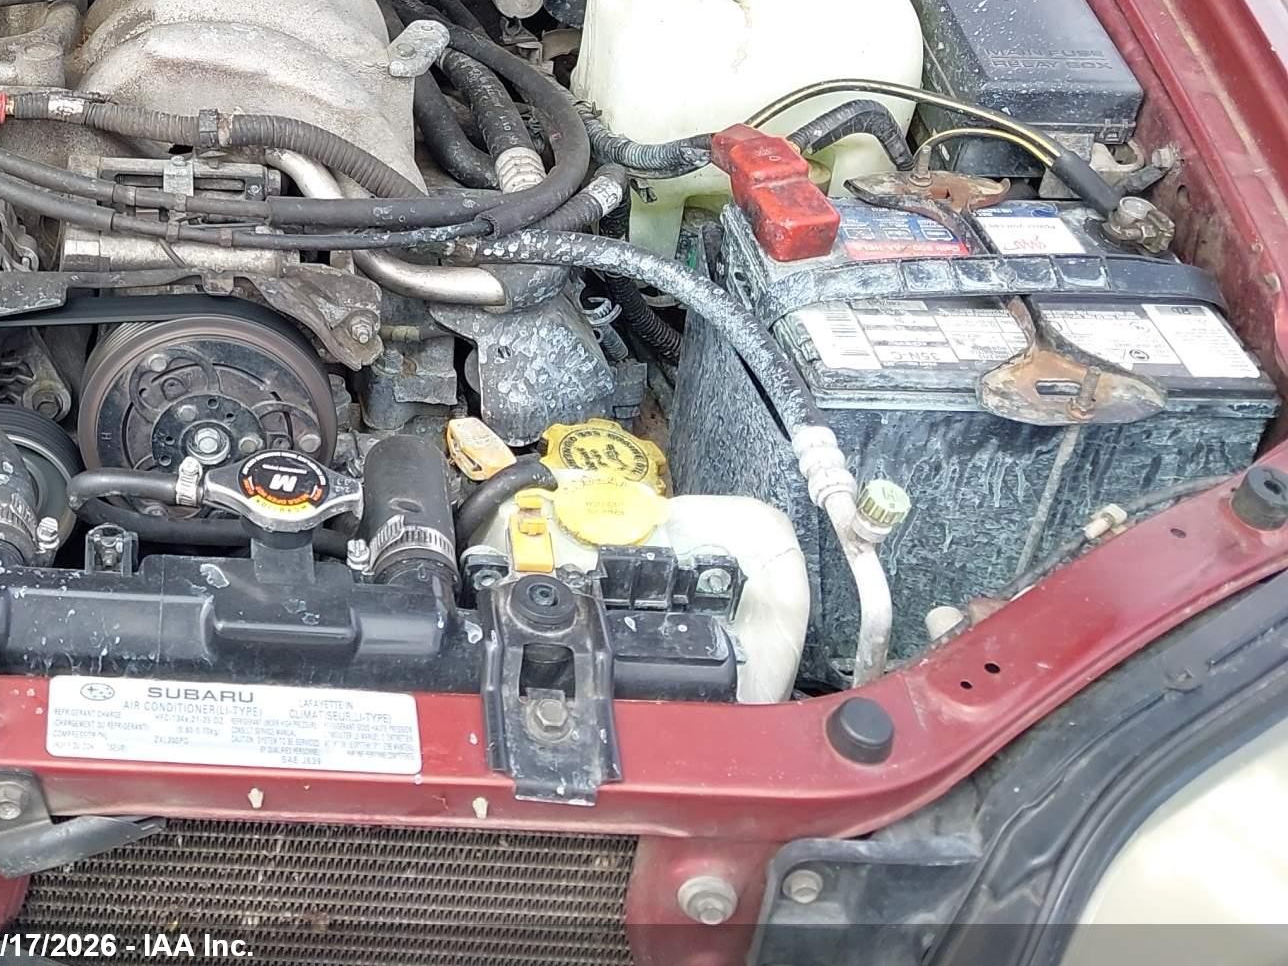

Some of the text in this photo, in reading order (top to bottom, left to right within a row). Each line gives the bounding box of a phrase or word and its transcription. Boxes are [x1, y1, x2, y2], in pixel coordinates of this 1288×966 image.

[984, 48, 1105, 57] MAIN FUSE
[991, 59, 1114, 70] RELAY BOX
[147, 686, 254, 703] SUBARU
[122, 699, 141, 711] AIR
